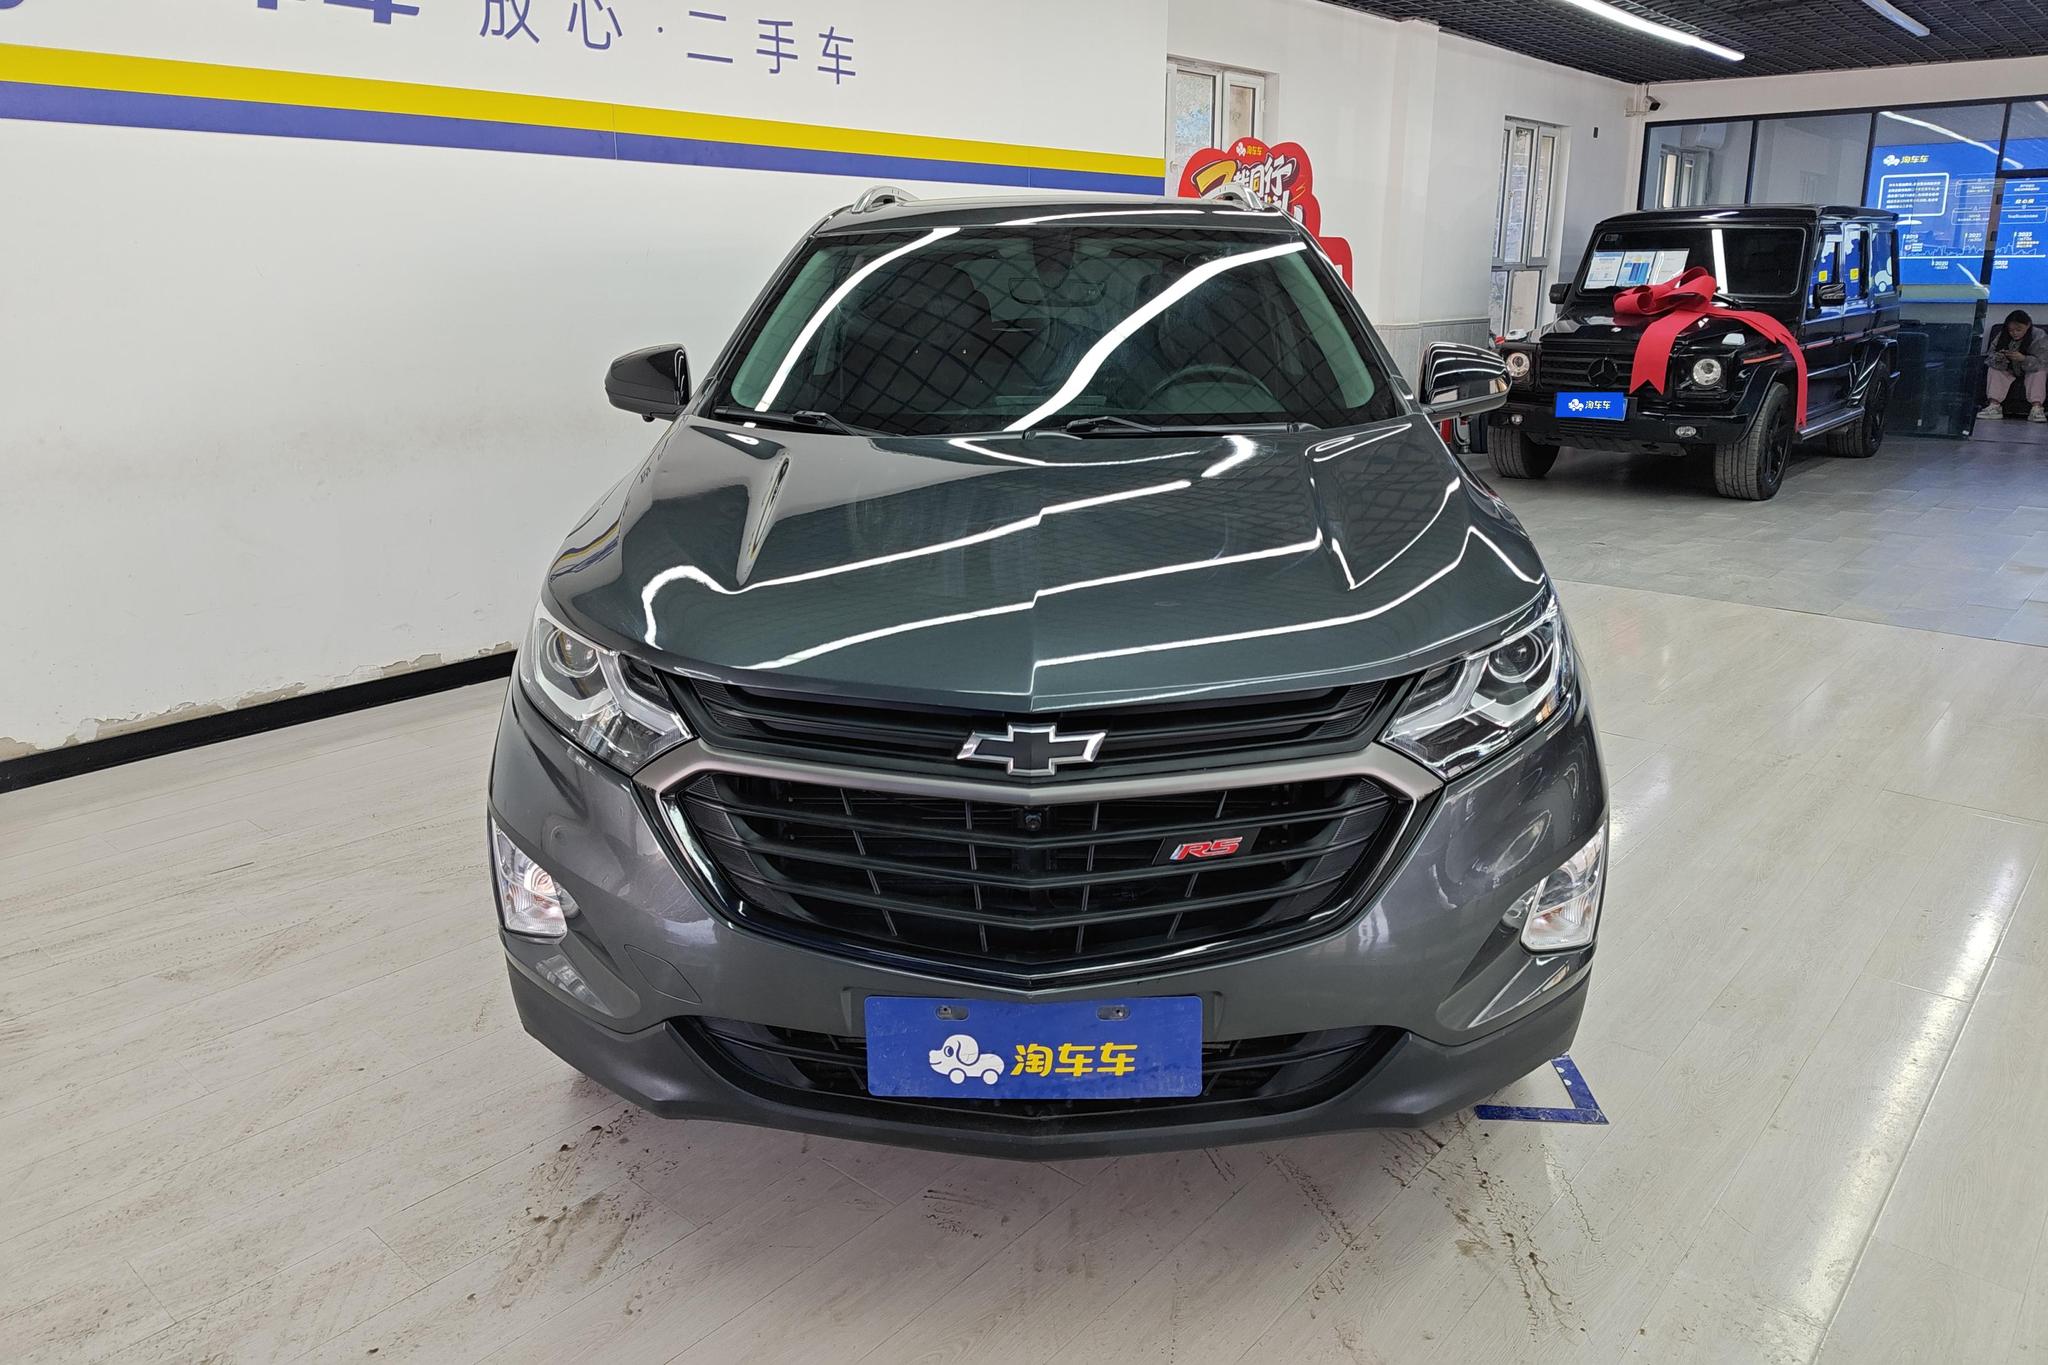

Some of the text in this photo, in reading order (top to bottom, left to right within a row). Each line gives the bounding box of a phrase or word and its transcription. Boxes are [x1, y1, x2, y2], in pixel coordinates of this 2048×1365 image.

[1585, 400, 1612, 410] 淘车车
[1171, 836, 1244, 861] RS
[1010, 1041, 1138, 1078] 淘车车
